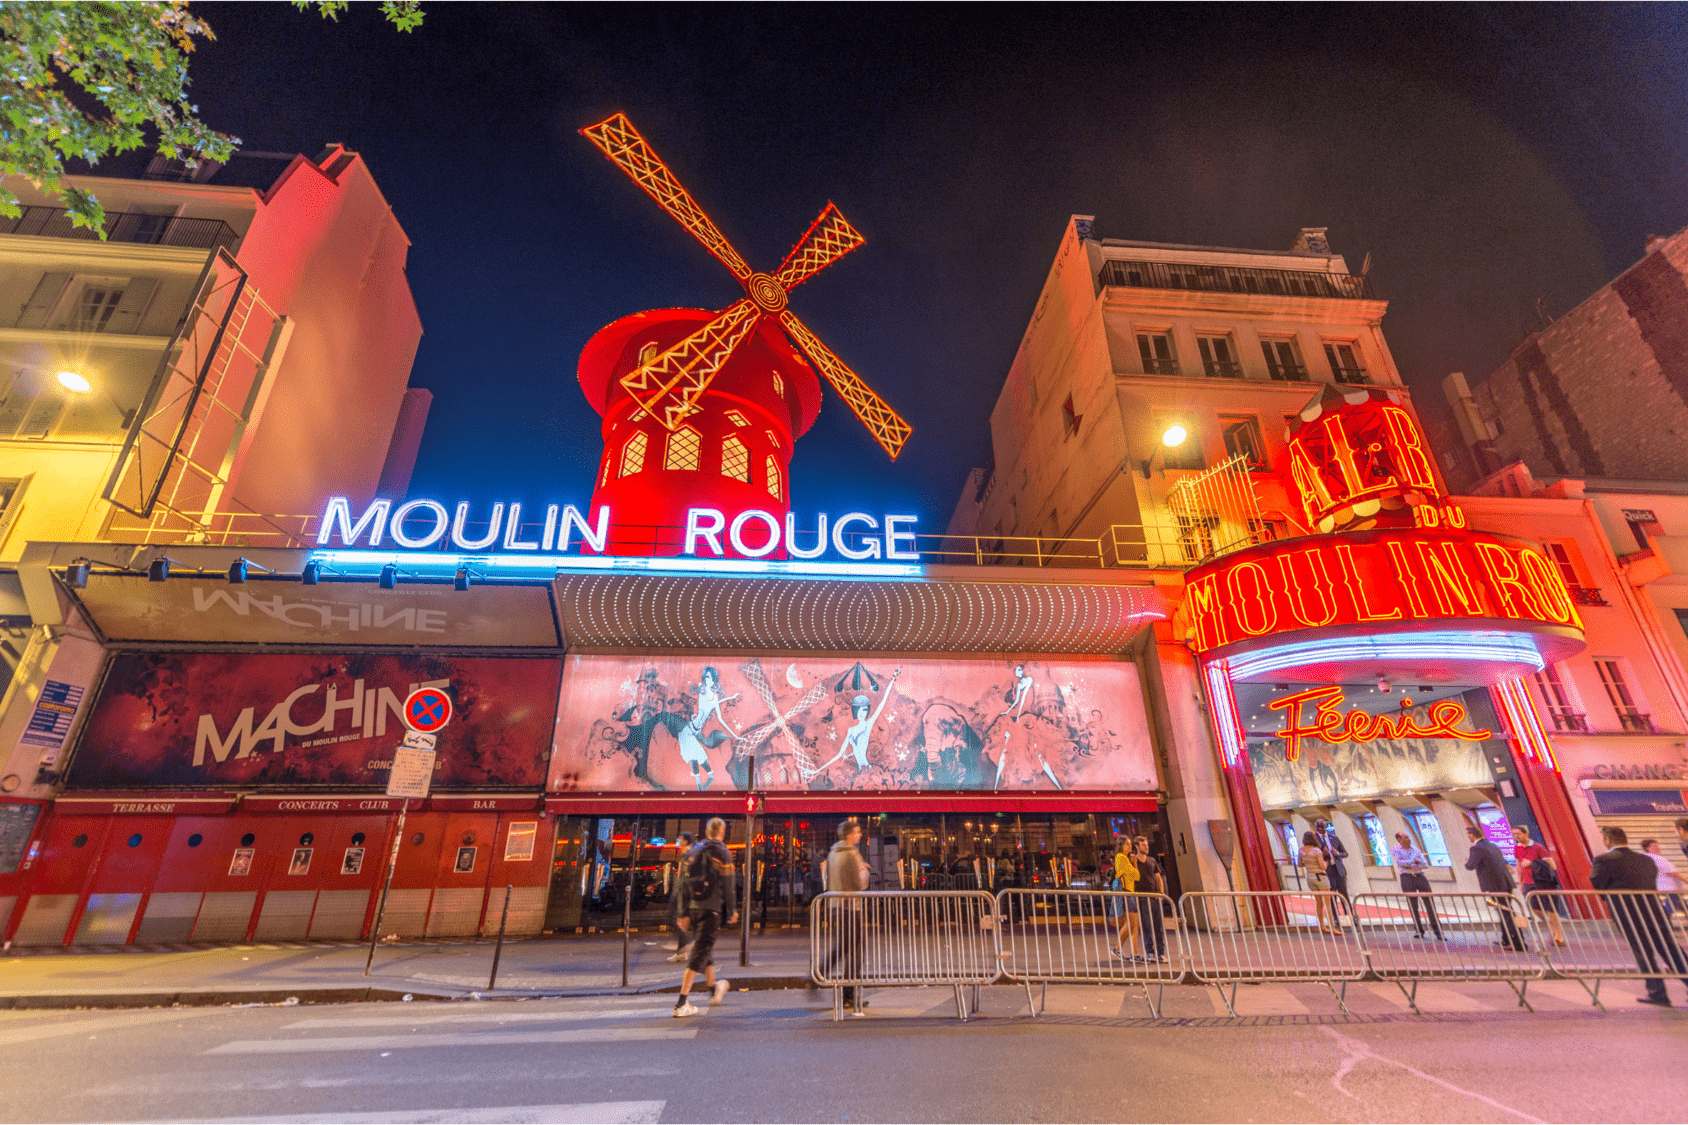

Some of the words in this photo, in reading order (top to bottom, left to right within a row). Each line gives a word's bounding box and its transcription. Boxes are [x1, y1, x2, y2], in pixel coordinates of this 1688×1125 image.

[1421, 504, 1466, 530] DU
[1624, 511, 1655, 521] Quick
[316, 497, 611, 552] MOULIN
[685, 507, 921, 560] ROUGE
[1186, 540, 1484, 653] MOULIN
[326, 682, 338, 690] LA
[39, 702, 75, 714] castorama
[1268, 685, 1492, 761] Féerie
[302, 740, 312, 748] DU
[312, 737, 338, 747] MOULIN
[339, 733, 361, 743] ROUGE
[112, 803, 175, 812] TERRASSE
[278, 800, 339, 810] CONCERTS
[359, 801, 389, 810] CLUB
[472, 801, 496, 809] BAR
